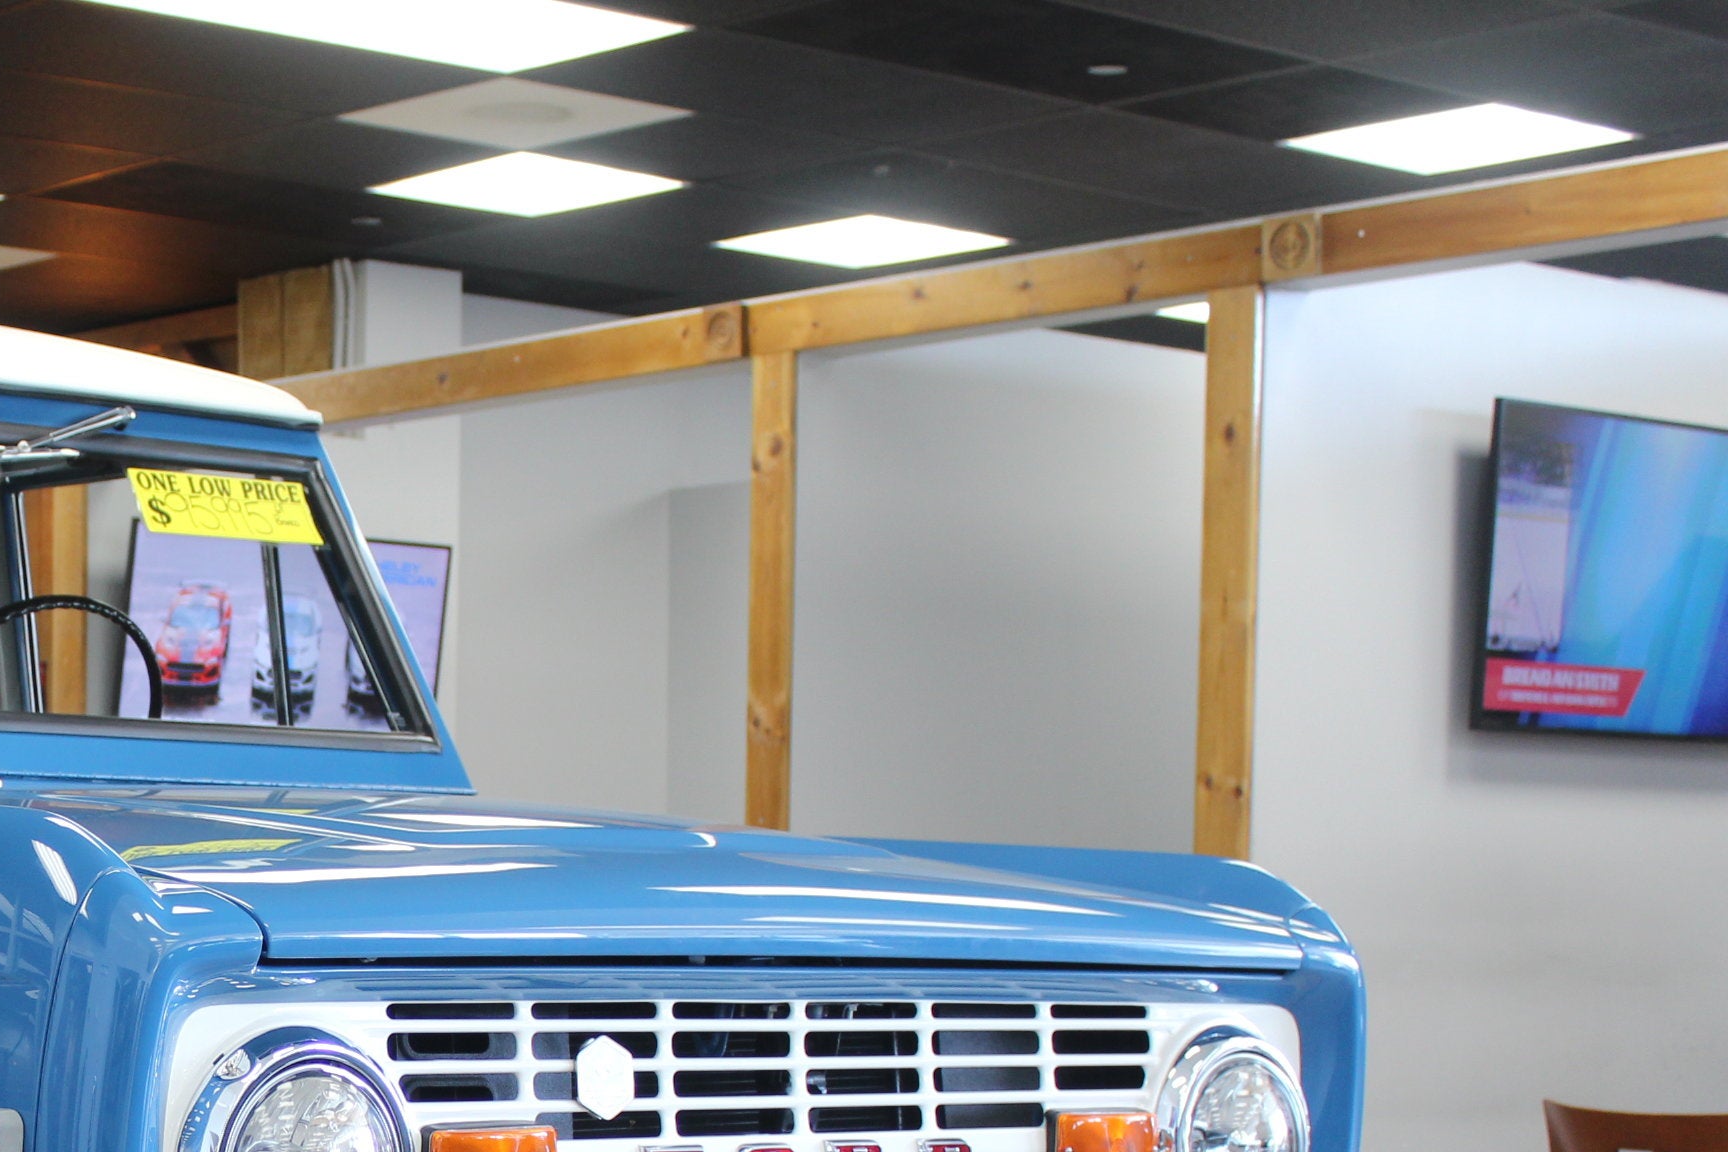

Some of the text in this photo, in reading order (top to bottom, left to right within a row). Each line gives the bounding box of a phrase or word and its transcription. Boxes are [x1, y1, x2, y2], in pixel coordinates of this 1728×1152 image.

[136, 471, 301, 504] ONE LOW PRICE
